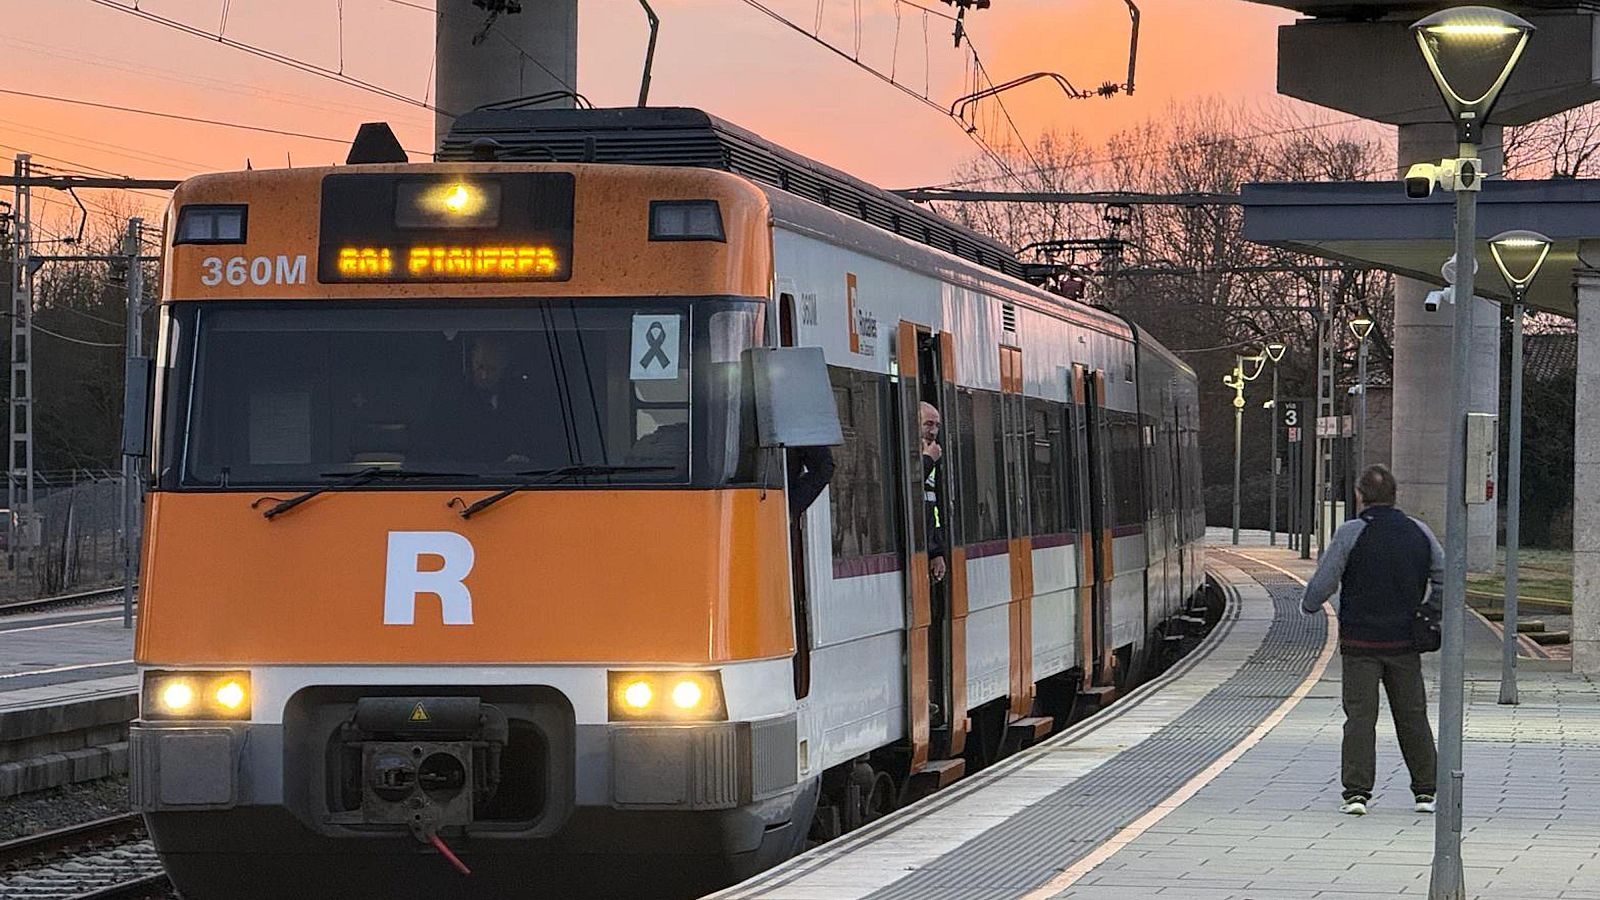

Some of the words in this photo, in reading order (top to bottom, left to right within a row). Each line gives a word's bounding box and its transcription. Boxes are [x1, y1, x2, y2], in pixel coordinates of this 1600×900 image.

[201, 255, 307, 286] 360M
[1285, 410, 1297, 425] 3
[384, 531, 475, 624] R
